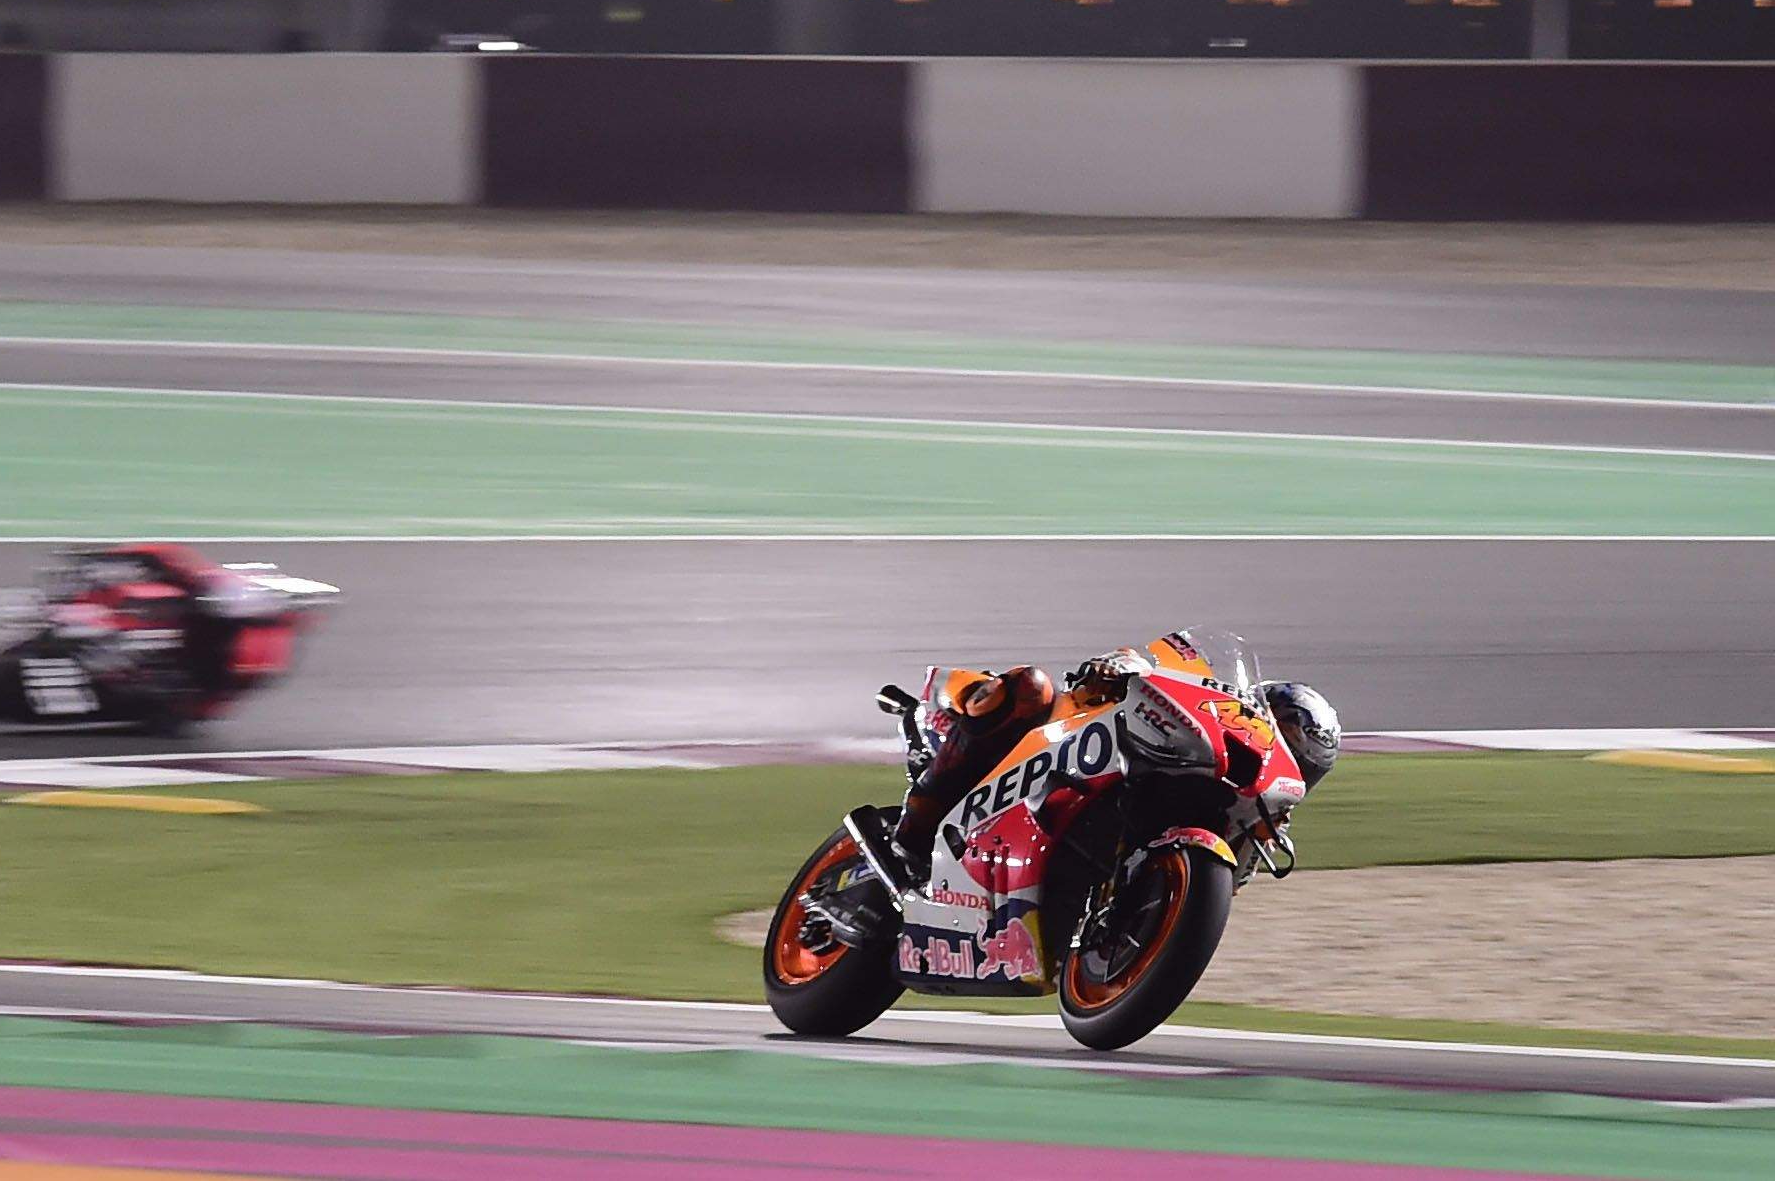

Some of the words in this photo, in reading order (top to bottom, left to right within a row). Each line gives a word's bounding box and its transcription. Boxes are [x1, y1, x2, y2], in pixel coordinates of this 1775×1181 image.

[1134, 702, 1177, 736] HRC
[1139, 682, 1201, 738] HONDA
[933, 889, 991, 911] HONDA
[935, 939, 975, 978] Bull
